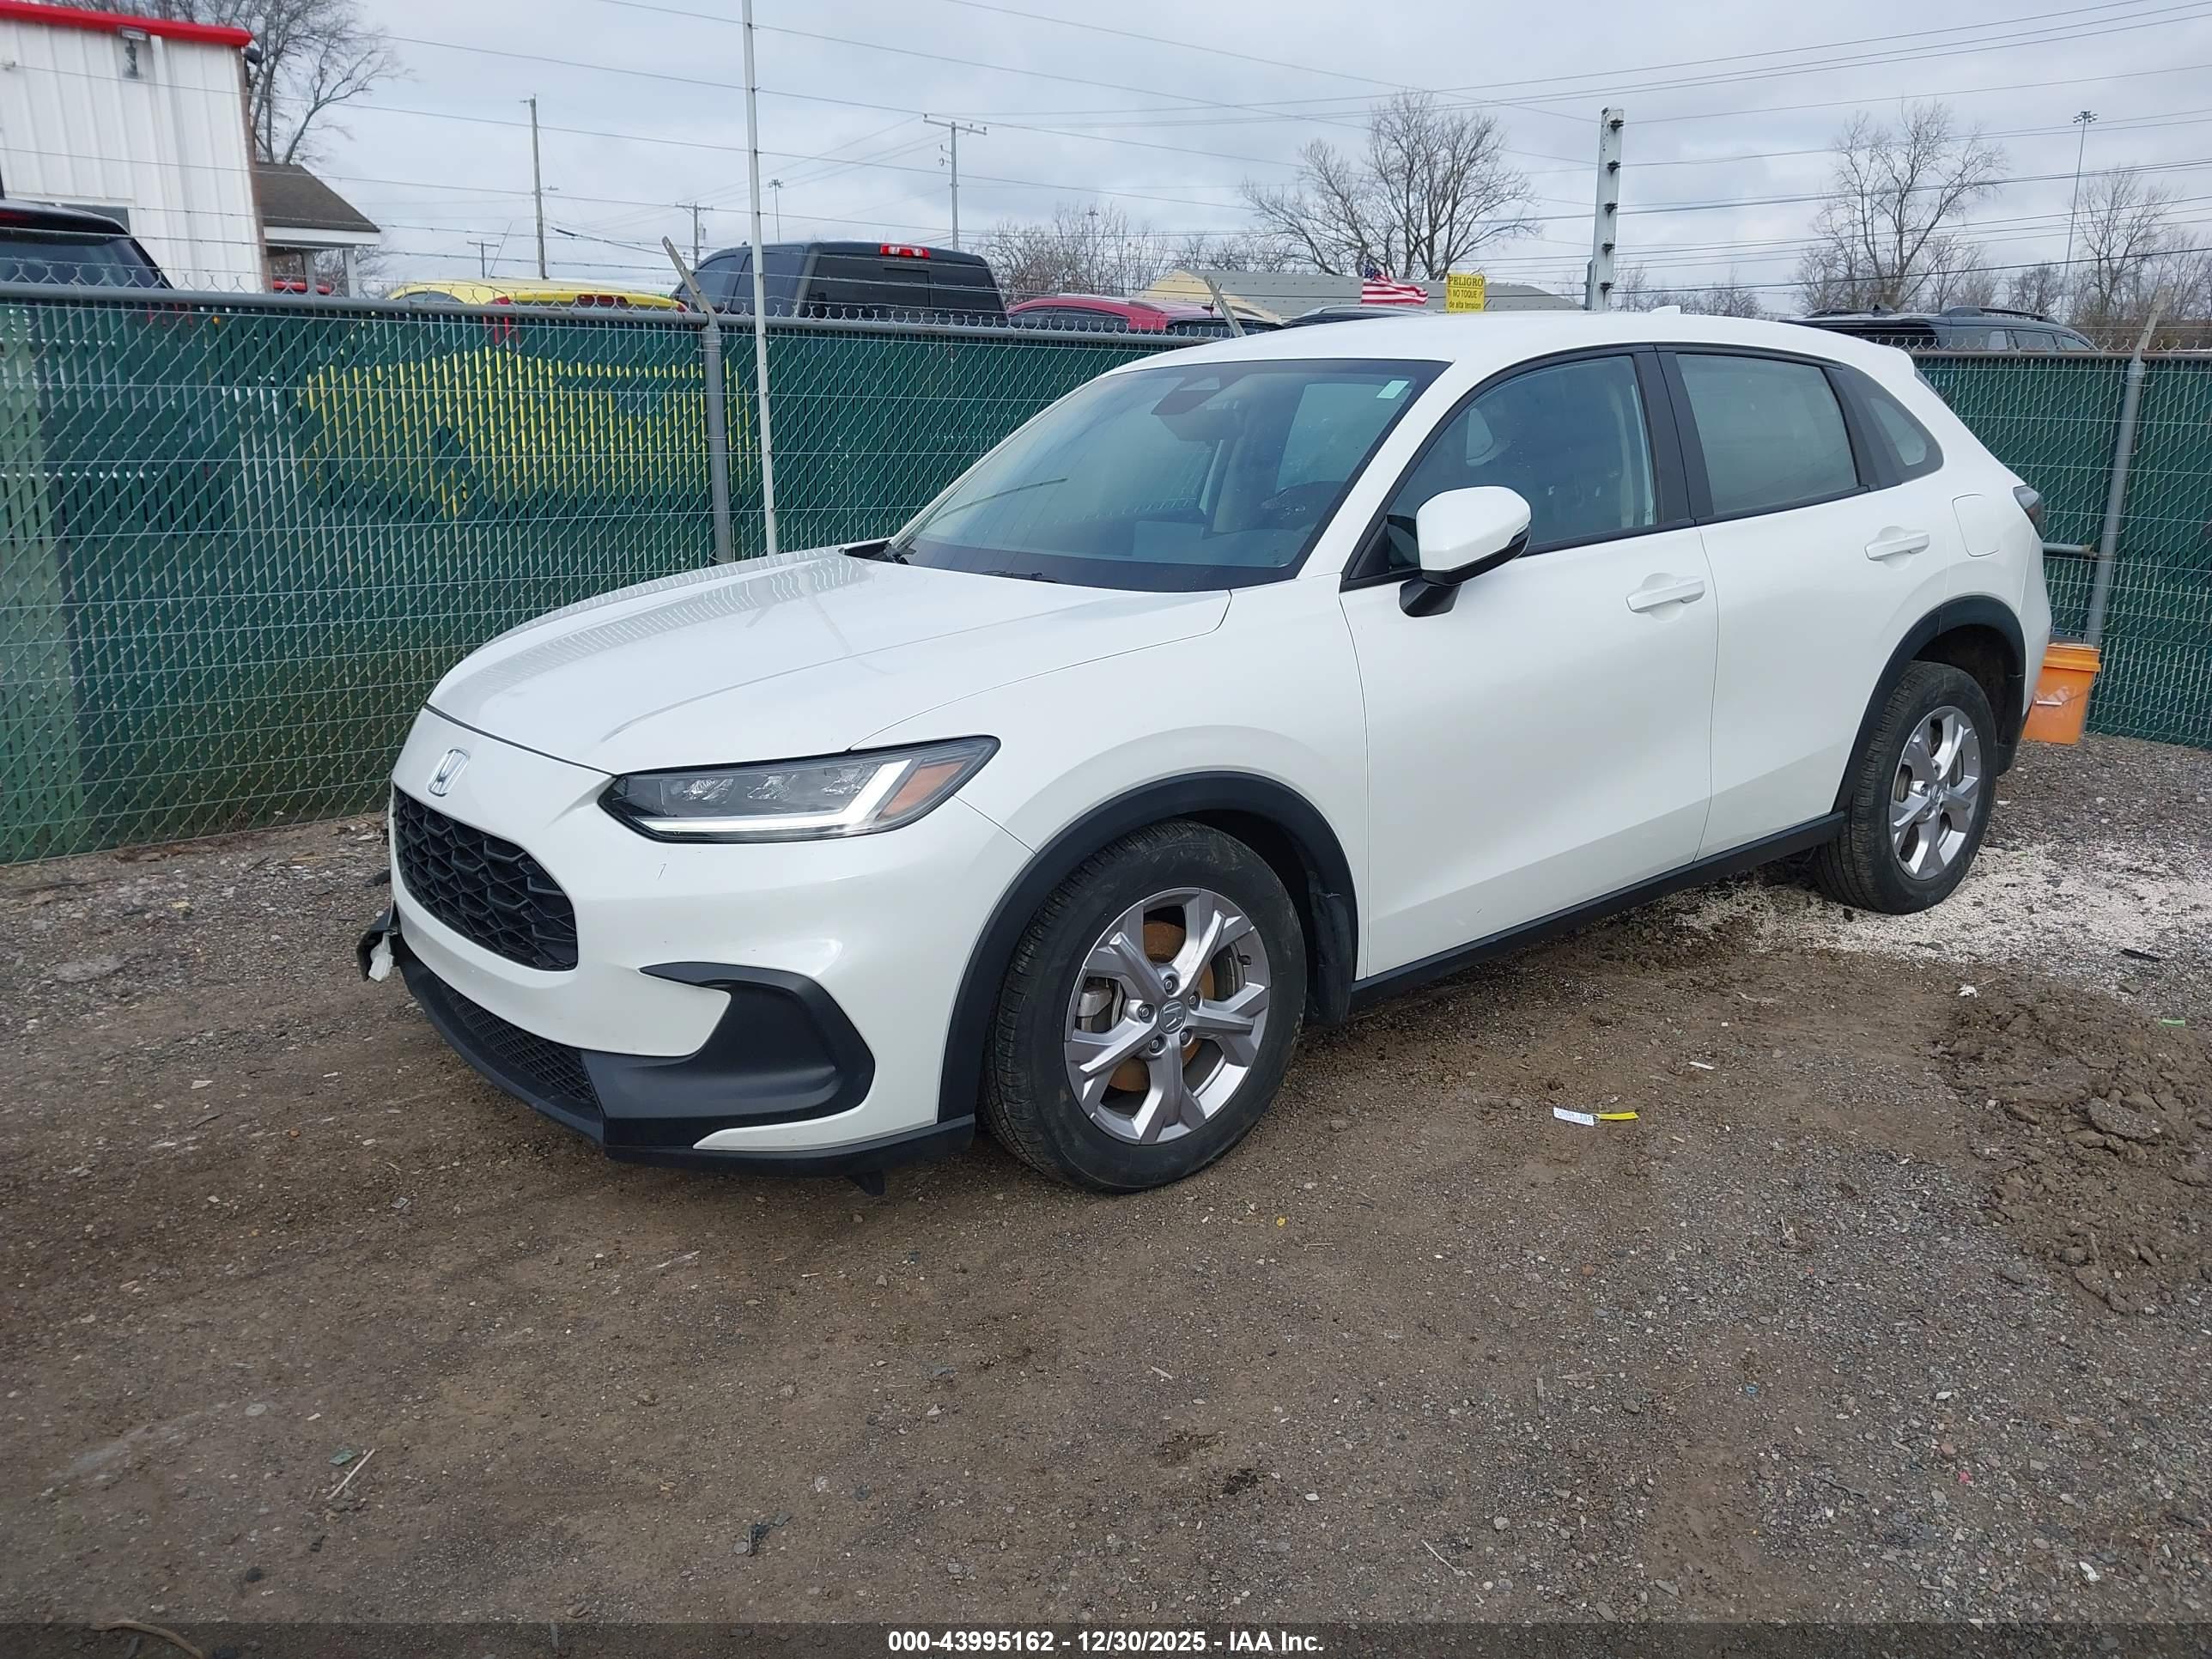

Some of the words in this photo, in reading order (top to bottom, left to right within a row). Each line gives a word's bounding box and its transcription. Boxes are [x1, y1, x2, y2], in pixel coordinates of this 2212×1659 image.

[1448, 276, 1484, 287] PELIGRO
[1453, 289, 1461, 298] NO
[1461, 289, 1478, 299] TOQUE
